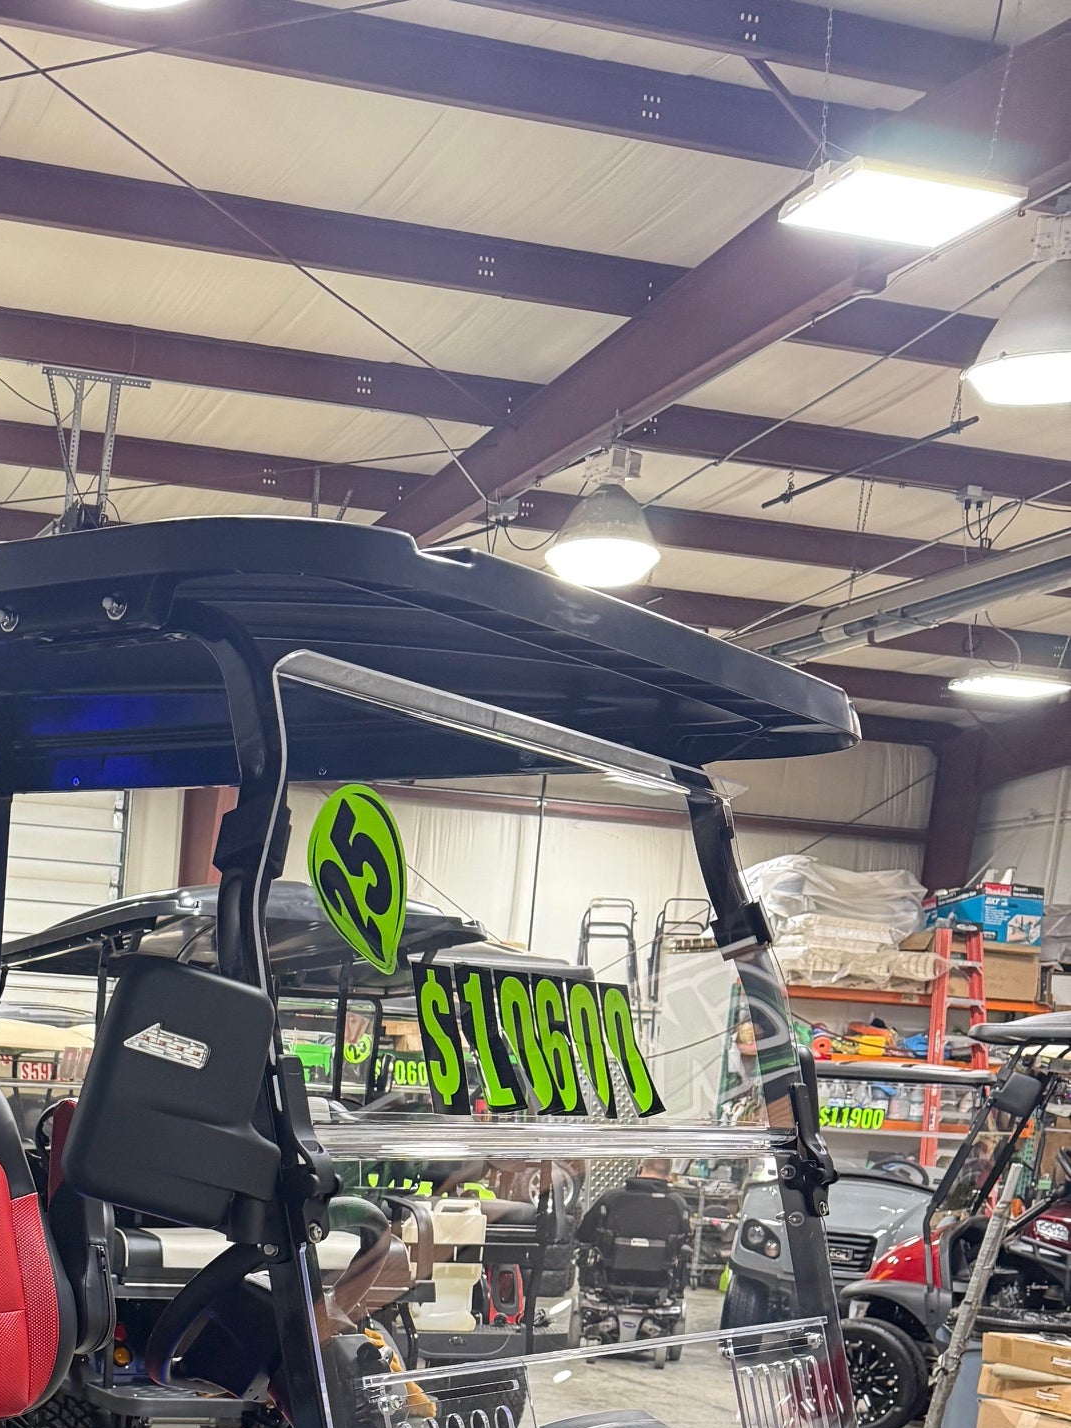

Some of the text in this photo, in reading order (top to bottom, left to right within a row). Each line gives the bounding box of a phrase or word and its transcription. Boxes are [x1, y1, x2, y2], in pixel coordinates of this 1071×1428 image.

[319, 797, 394, 962] 25
[418, 967, 655, 1114] $10600
[819, 1105, 885, 1131] $11900
